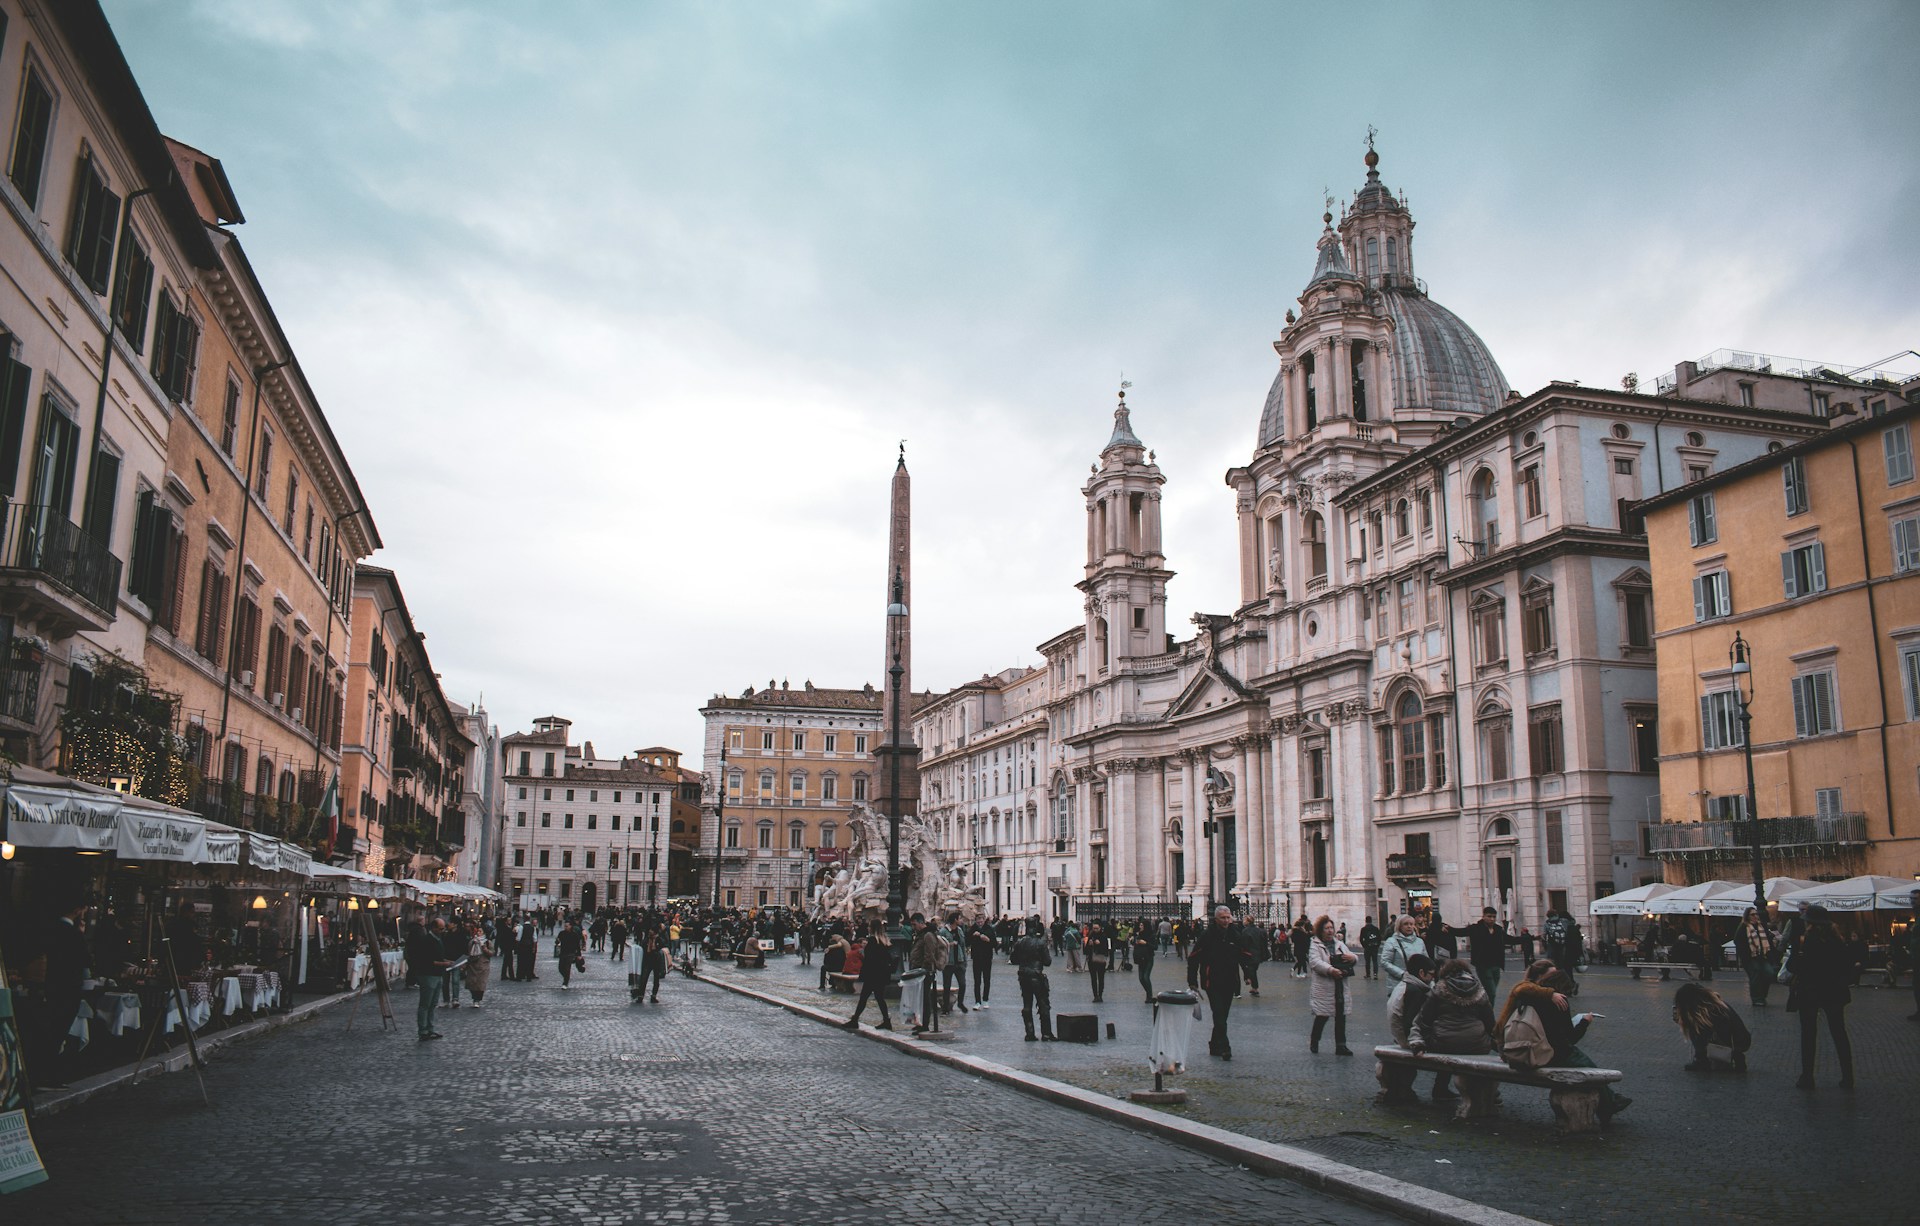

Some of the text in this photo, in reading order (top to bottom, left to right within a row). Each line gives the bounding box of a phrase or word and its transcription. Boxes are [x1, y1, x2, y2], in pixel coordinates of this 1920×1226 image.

[9, 800, 47, 824] Antica
[45, 803, 86, 827] Trattoria
[138, 822, 193, 843] Pizzeria Wine Bar
